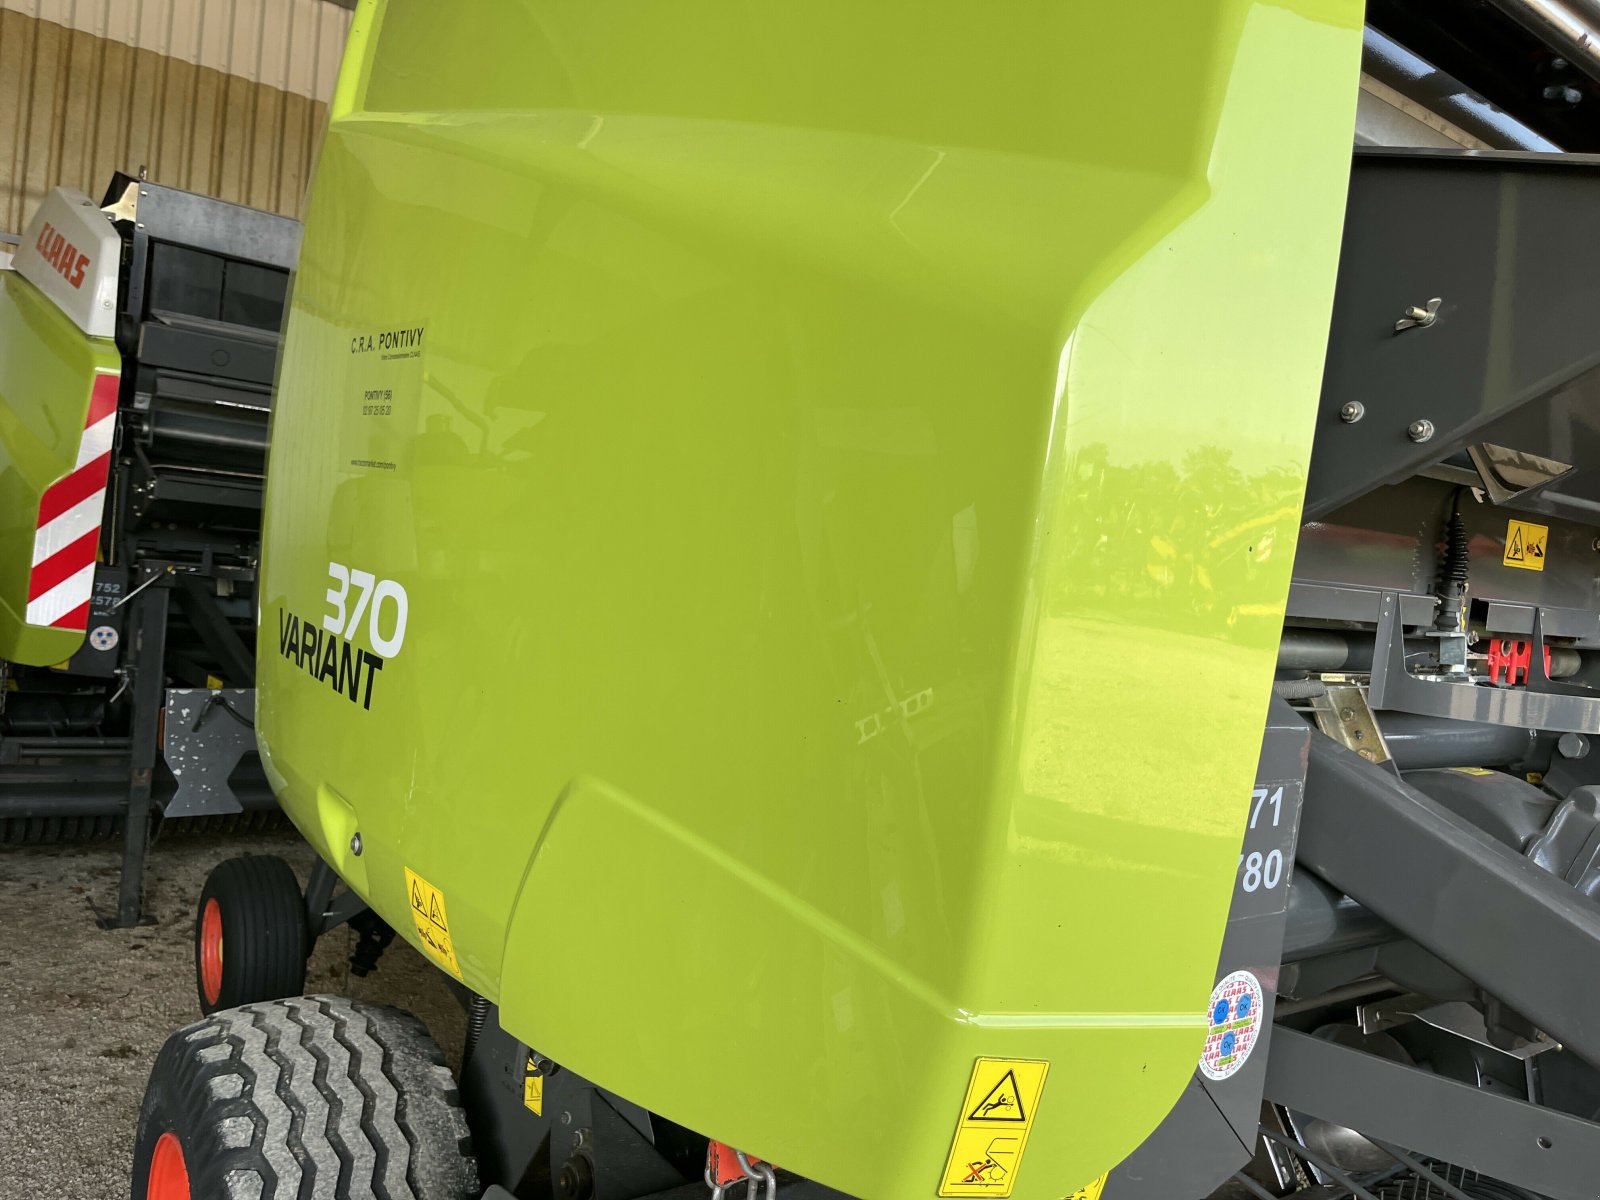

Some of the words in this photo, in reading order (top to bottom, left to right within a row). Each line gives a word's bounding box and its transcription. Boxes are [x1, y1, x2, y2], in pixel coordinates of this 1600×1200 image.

[36, 221, 90, 290] CLAAS
[351, 335, 375, 354] C.R.A.
[378, 327, 424, 350] PONTIVY
[322, 561, 409, 659] 370
[279, 607, 384, 711] VARIANT
[1249, 786, 1283, 829] 71
[1237, 848, 1283, 893] 80
